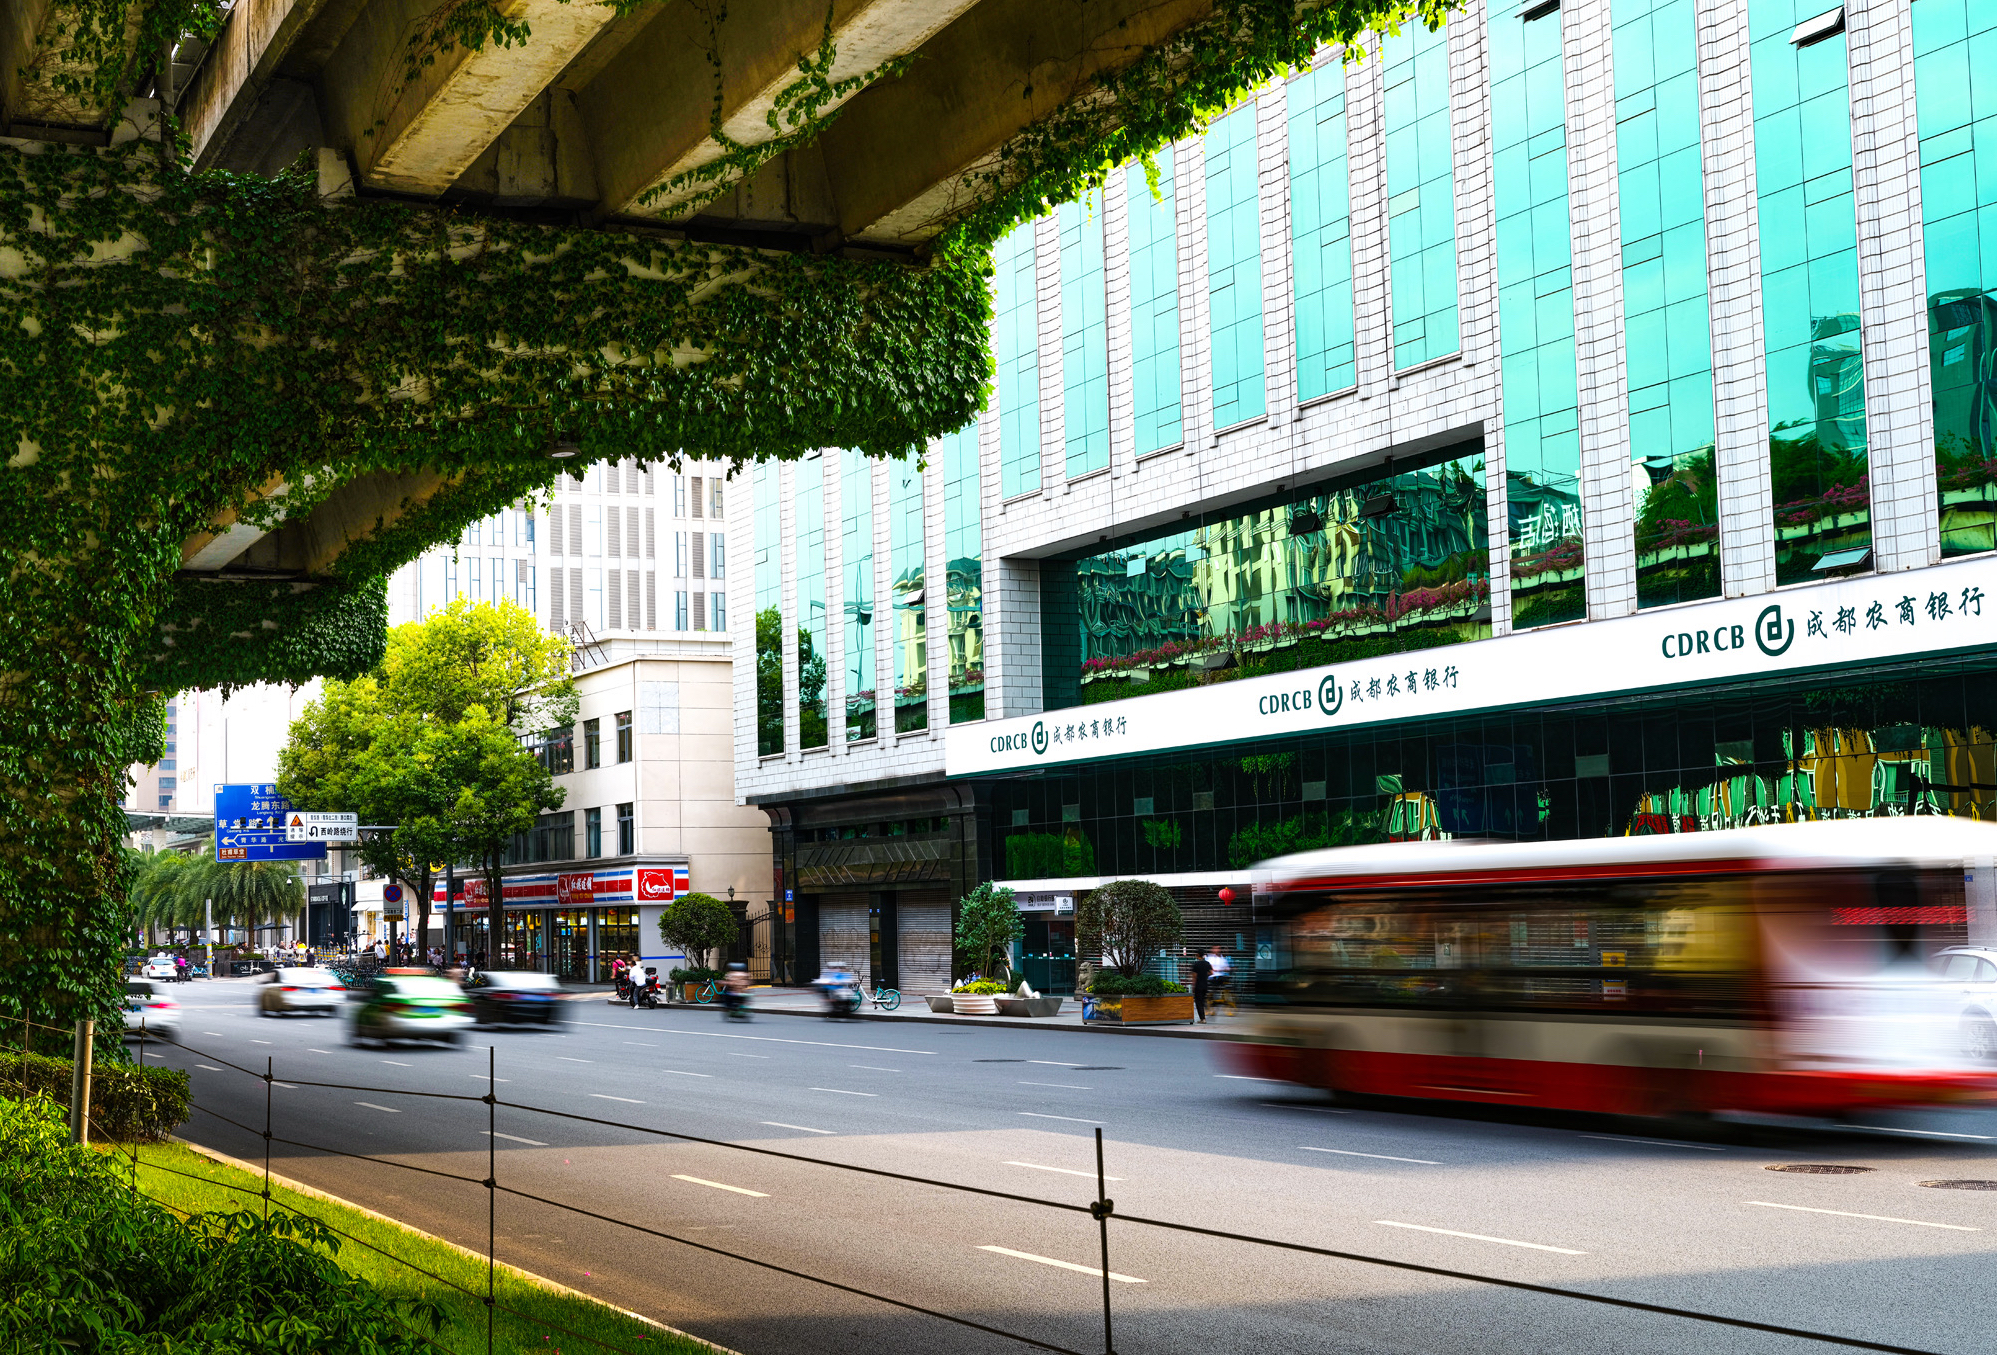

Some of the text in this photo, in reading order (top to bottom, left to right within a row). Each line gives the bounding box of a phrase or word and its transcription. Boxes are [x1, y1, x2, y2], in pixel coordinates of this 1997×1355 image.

[1662, 586, 1986, 659] CDRCB 成都农商银行
[1259, 665, 1459, 715] CDRCB 成都农商银行
[990, 716, 1127, 753] CDRCB 成都农商银行
[250, 801, 291, 811] 龙腾东路
[320, 827, 353, 836] 西岭路绕行
